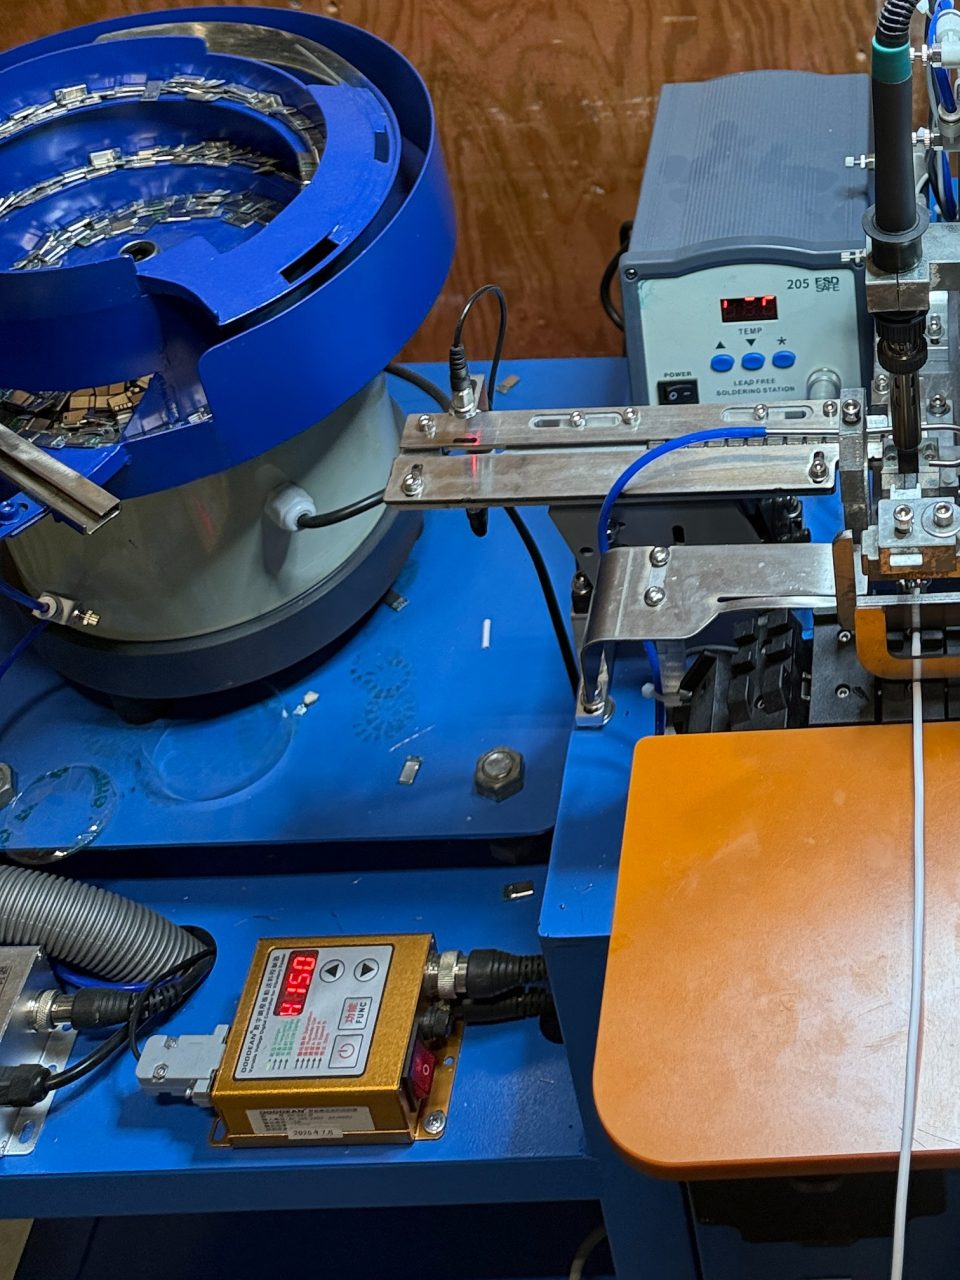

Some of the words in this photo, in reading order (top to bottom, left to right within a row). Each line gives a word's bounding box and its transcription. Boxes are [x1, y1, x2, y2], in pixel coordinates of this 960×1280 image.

[787, 278, 810, 289] 205
[815, 276, 840, 285] ESD
[816, 283, 840, 293] SAFE
[738, 327, 763, 335] TEMP
[663, 370, 692, 378] POWER
[733, 379, 755, 387] LEAD
[756, 377, 777, 385] FREE
[716, 387, 762, 397] SOLDERING
[763, 385, 796, 394] STATION
[344, 1001, 359, 1024] 功能
[355, 1001, 368, 1024] FUNC
